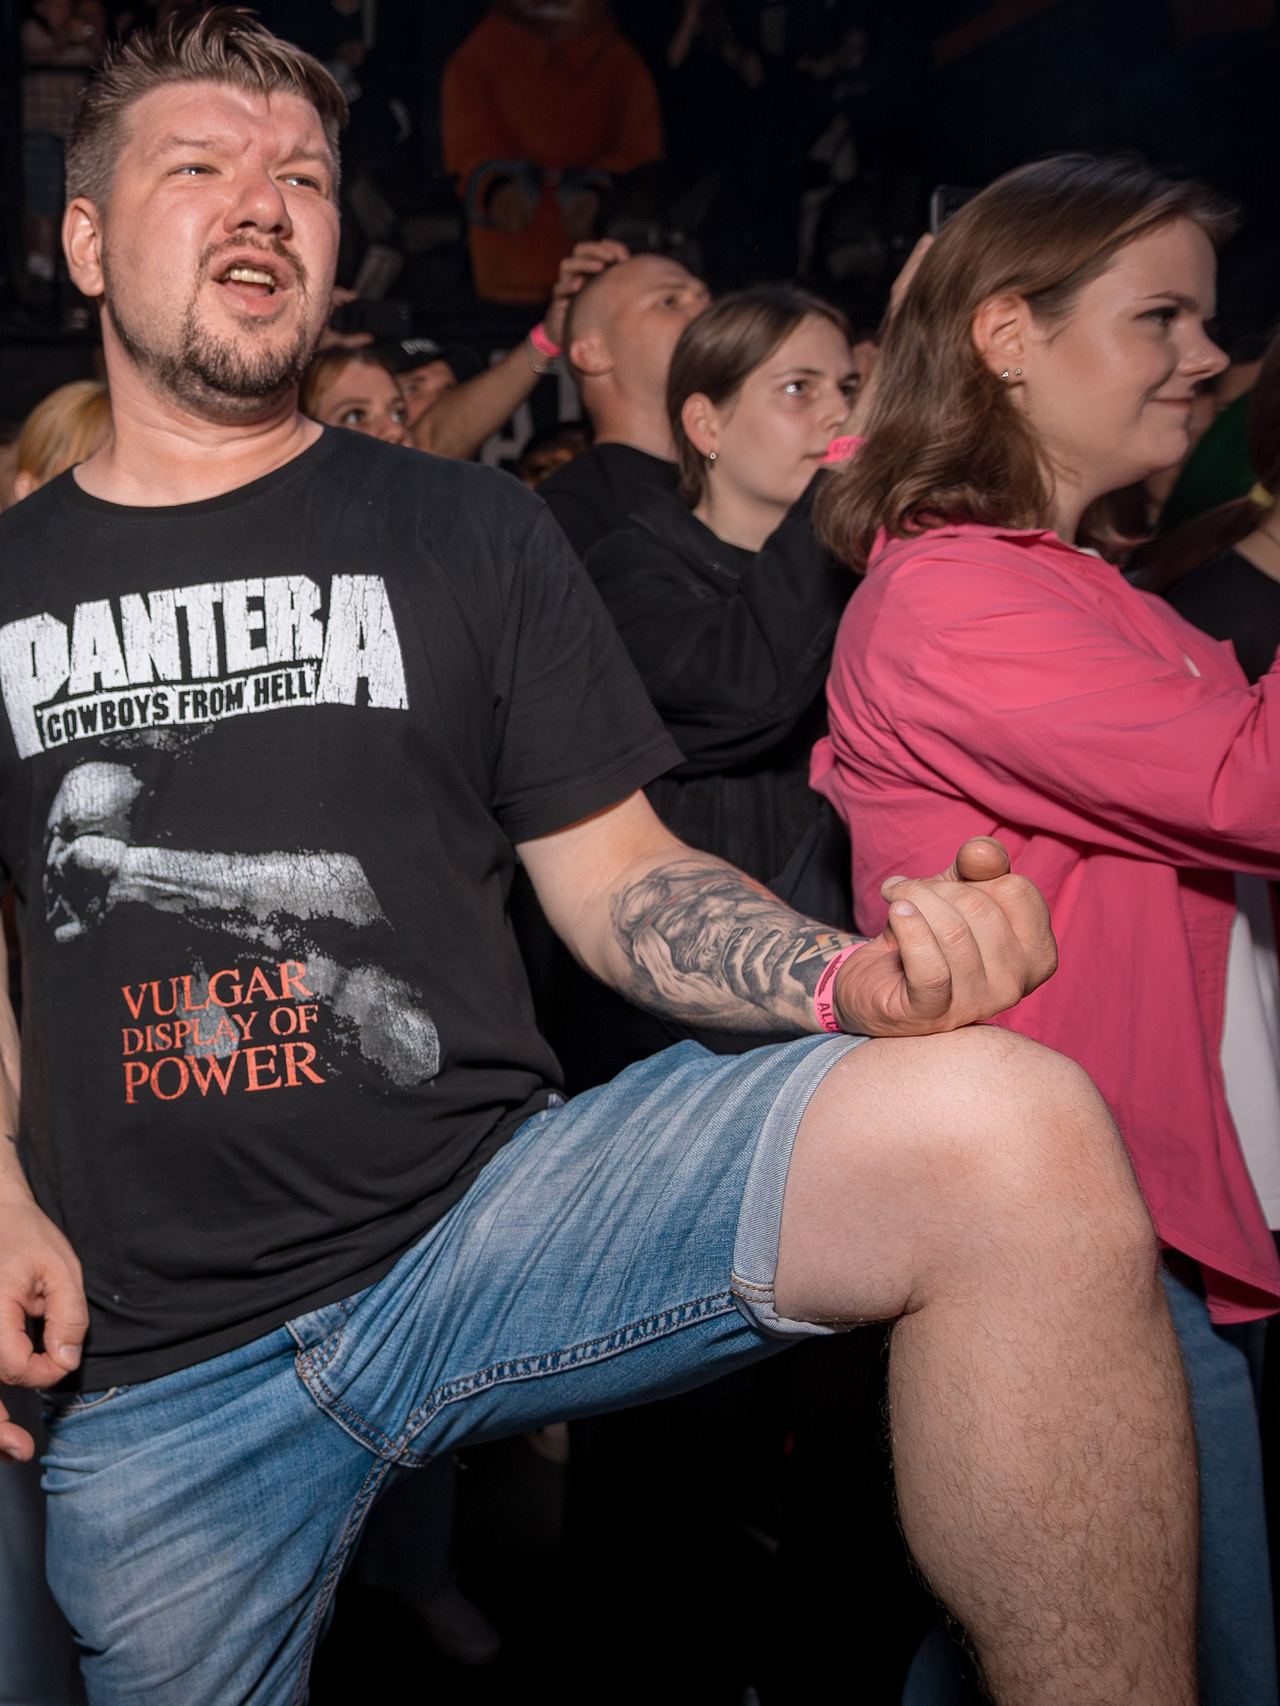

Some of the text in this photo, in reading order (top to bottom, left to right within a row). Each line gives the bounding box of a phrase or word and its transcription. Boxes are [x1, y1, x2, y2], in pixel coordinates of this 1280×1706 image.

[47, 669, 313, 743] COWBOYS FROM HELL
[122, 961, 314, 1020] VULGAR
[122, 1004, 319, 1056] DISPLAY OF
[123, 1041, 326, 1104] POWER
